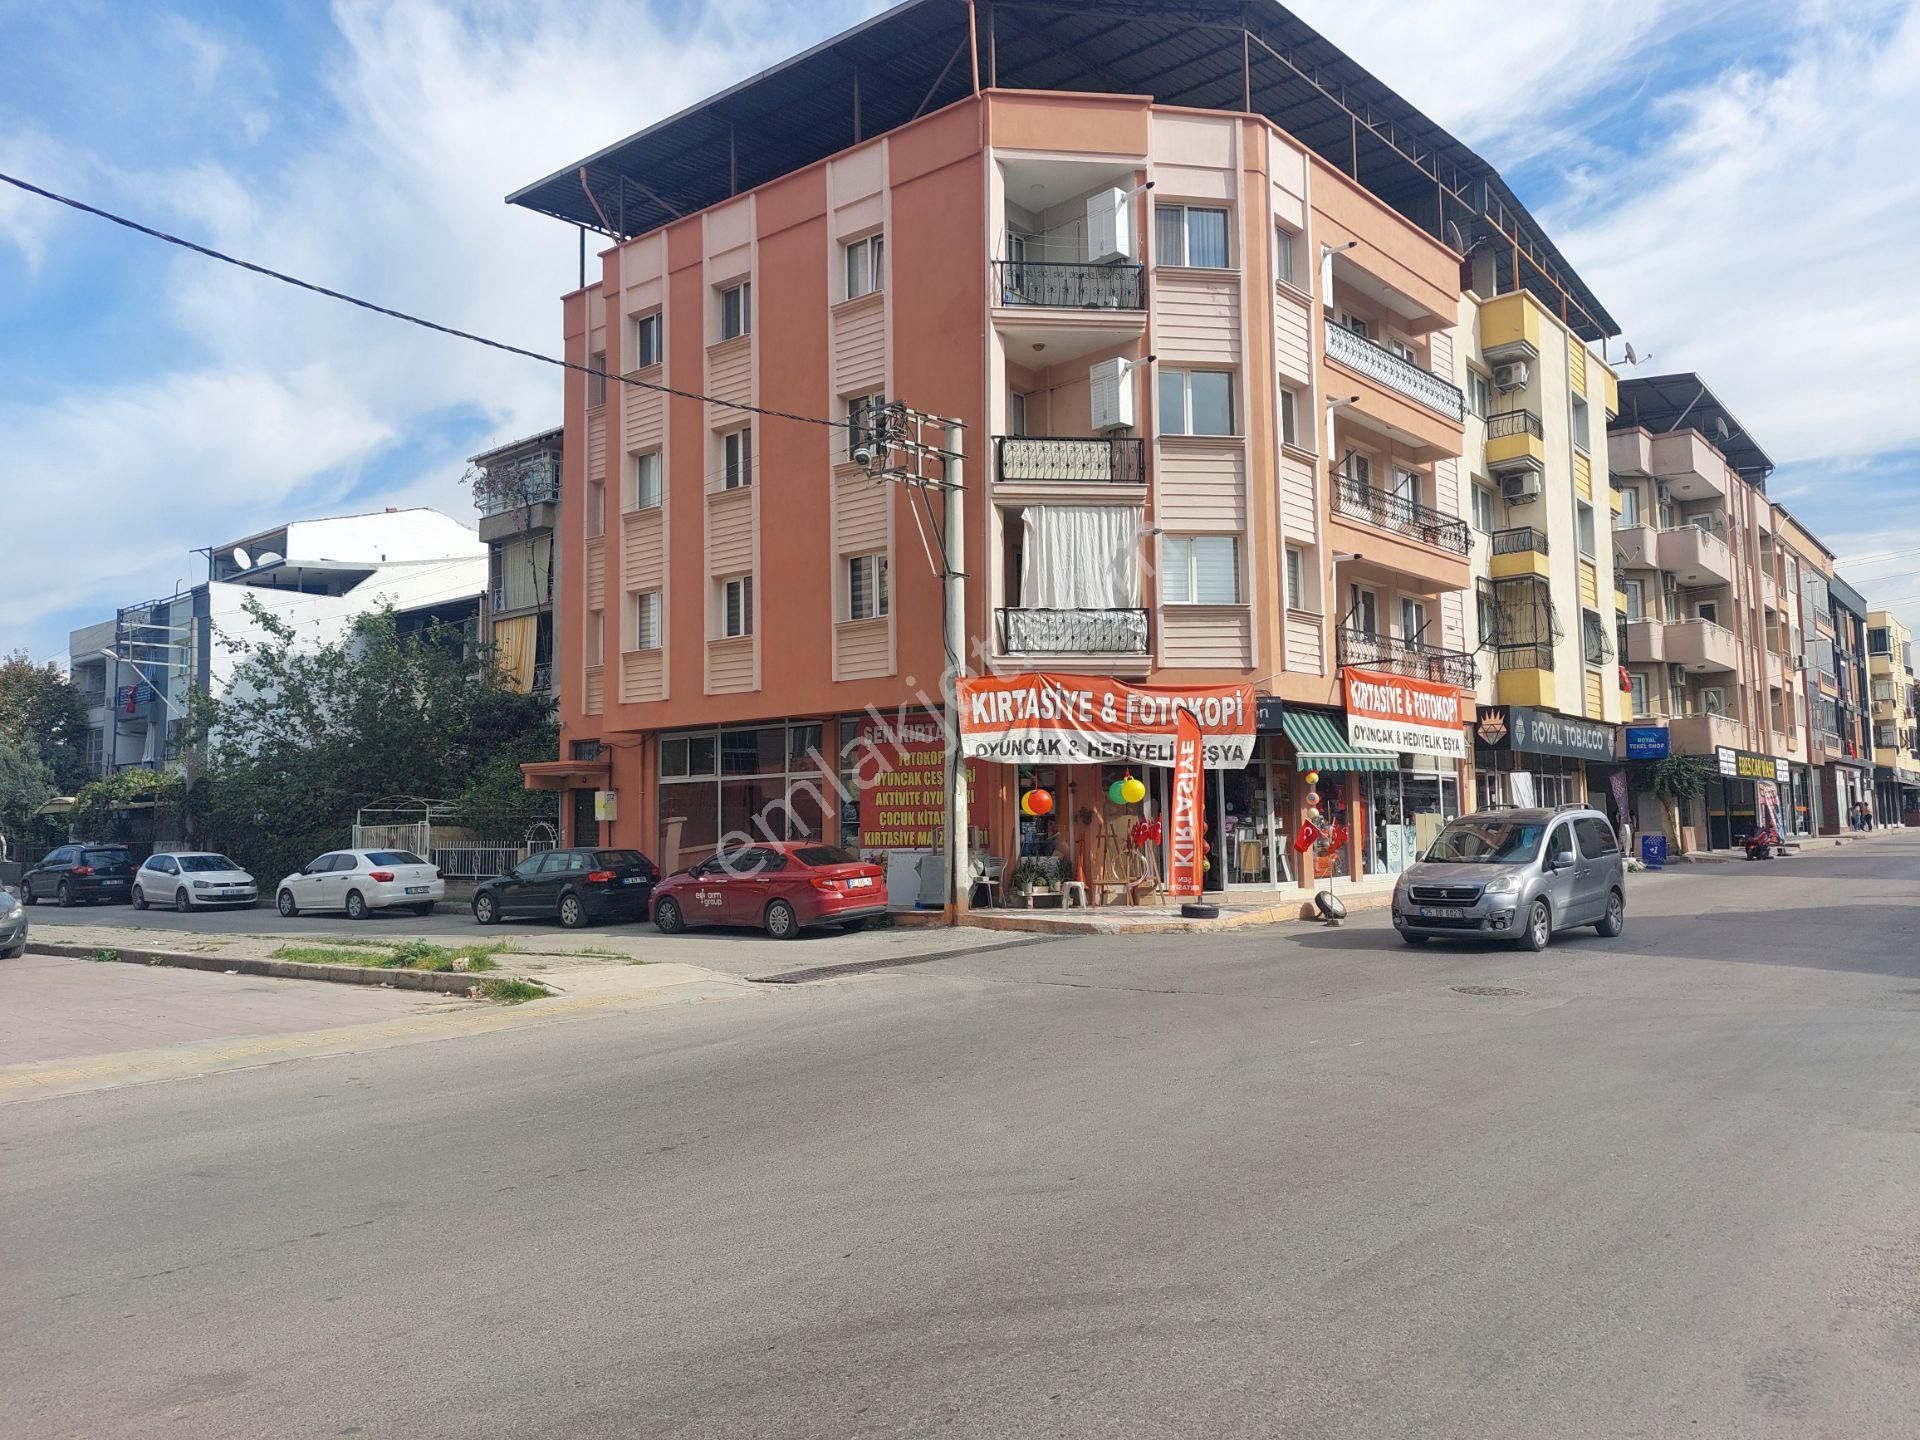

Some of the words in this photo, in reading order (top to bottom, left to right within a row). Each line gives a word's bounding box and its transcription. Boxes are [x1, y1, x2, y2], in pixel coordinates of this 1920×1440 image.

[971, 682, 1093, 724] KIRTASİYE
[1101, 692, 1118, 723] &
[1350, 680, 1404, 715] KIRTASİYE
[1405, 689, 1413, 716] &
[1413, 691, 1459, 723] FOTOKOPİ
[1354, 724, 1395, 744] OYUNCAK
[1403, 731, 1443, 750] HEDİYELİK
[1443, 736, 1460, 755] EŞYA
[1531, 720, 1563, 745] ROYAL
[1564, 726, 1604, 751] TOBACCO
[898, 750, 945, 766] FOTOKOP
[975, 738, 1061, 757] OYUNCAK
[1068, 739, 1080, 757] &
[1087, 740, 1174, 761] HEDİYELİ
[875, 771, 922, 786] OYUNCAK
[875, 789, 921, 806] AKTİVİTE
[879, 811, 915, 828] ÇOCUK
[864, 829, 915, 846] KIRTASİYE
[704, 899, 723, 907] group
